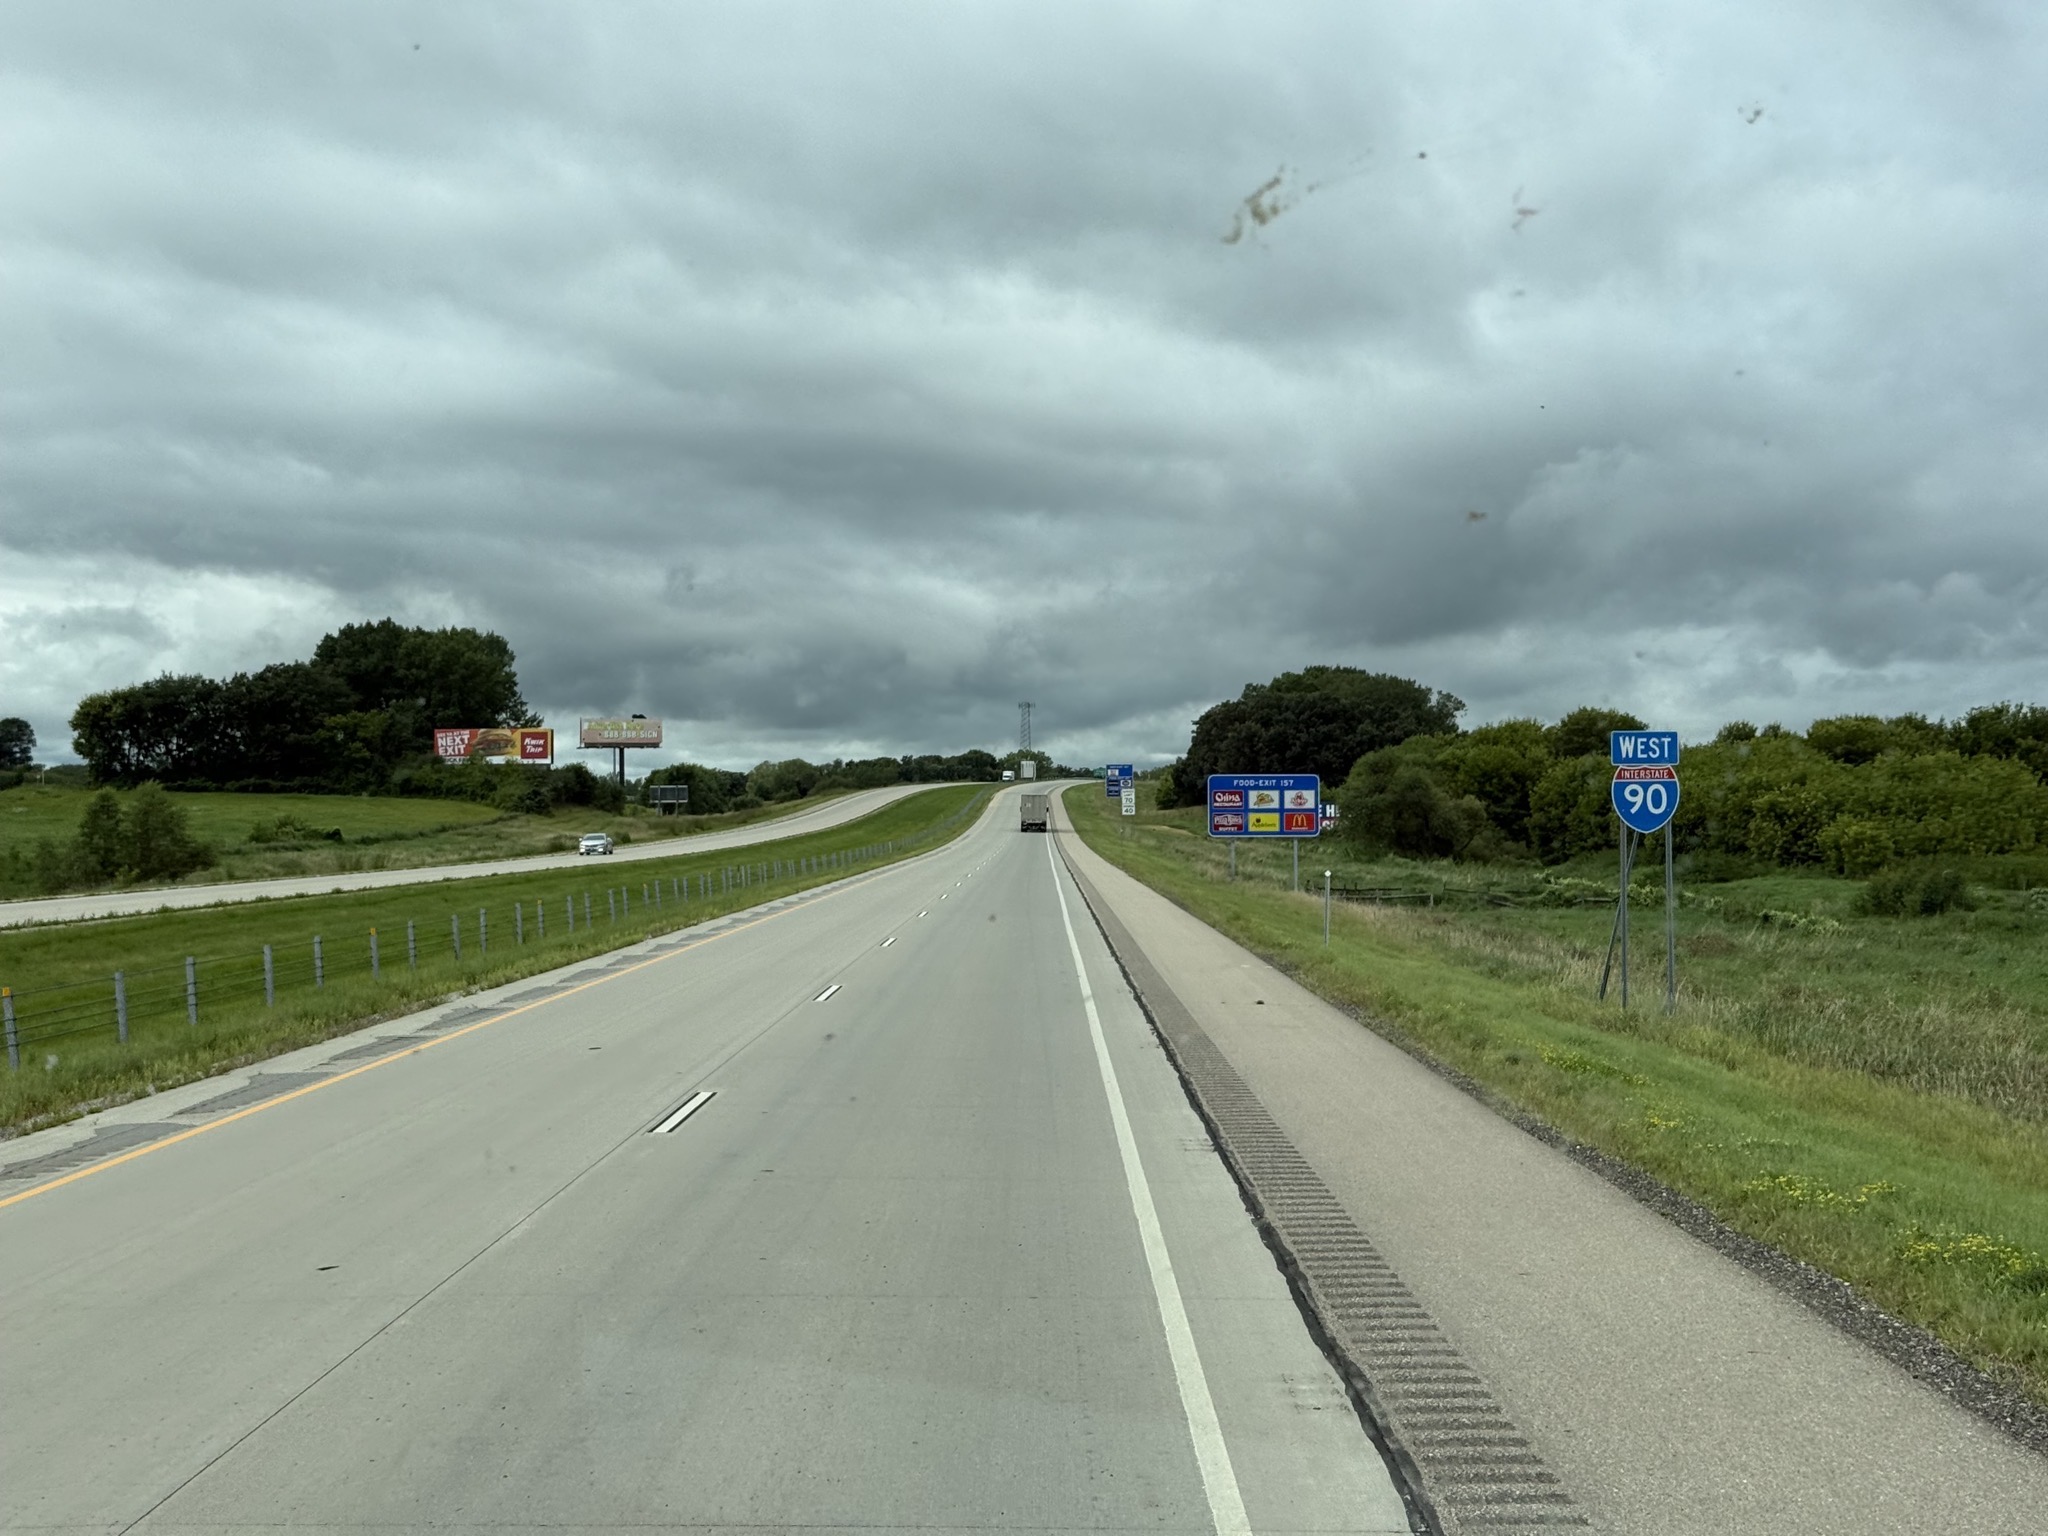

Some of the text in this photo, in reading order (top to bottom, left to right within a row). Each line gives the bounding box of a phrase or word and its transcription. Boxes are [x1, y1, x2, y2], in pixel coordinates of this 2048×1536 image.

[437, 734, 470, 747] NEXT
[438, 745, 467, 755] EXIT
[1619, 736, 1672, 758] WEST
[1621, 769, 1669, 779] INTERSTATE
[1233, 779, 1294, 787] FOOD-EXIT 157
[1624, 783, 1668, 815] 90
